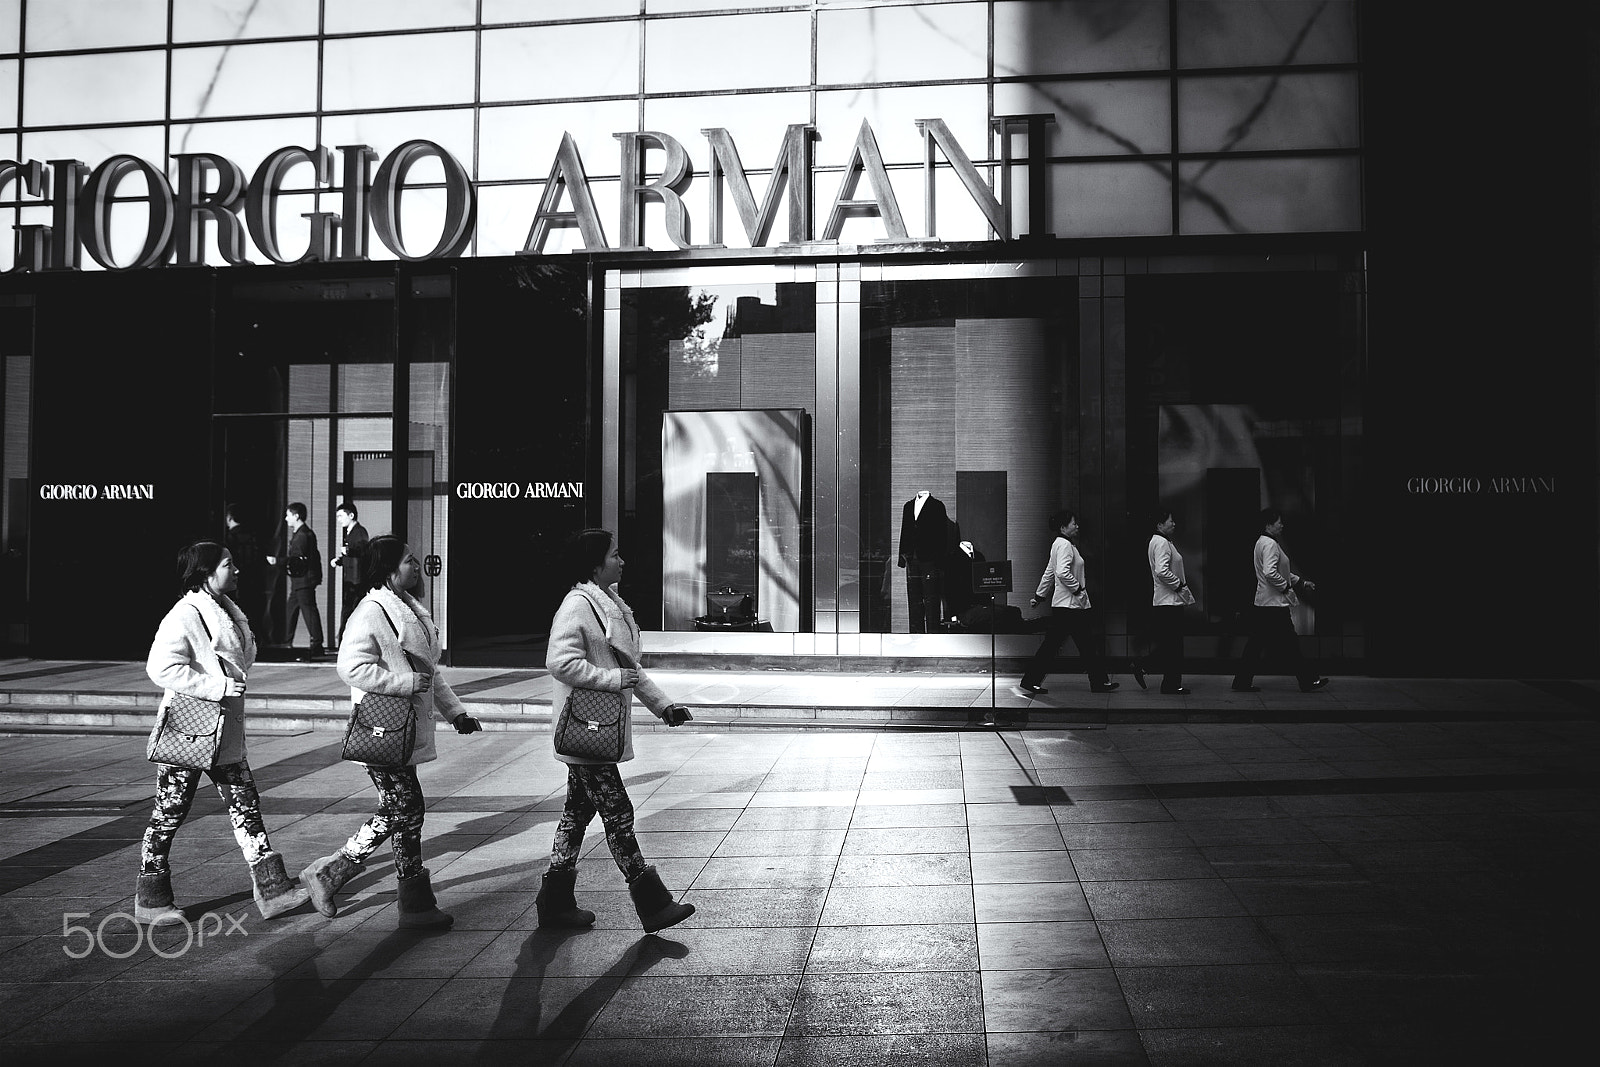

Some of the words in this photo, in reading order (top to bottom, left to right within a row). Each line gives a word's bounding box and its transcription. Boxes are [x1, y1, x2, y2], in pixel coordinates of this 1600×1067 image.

[515, 113, 1056, 255] ARMANI
[40, 484, 98, 500] GIORGIO
[100, 484, 154, 500] ARMANI
[456, 482, 520, 499] GIORGIO
[524, 482, 584, 498] ARMANI
[1407, 477, 1481, 494] GIORGIO
[1487, 477, 1556, 493] ARMANI
